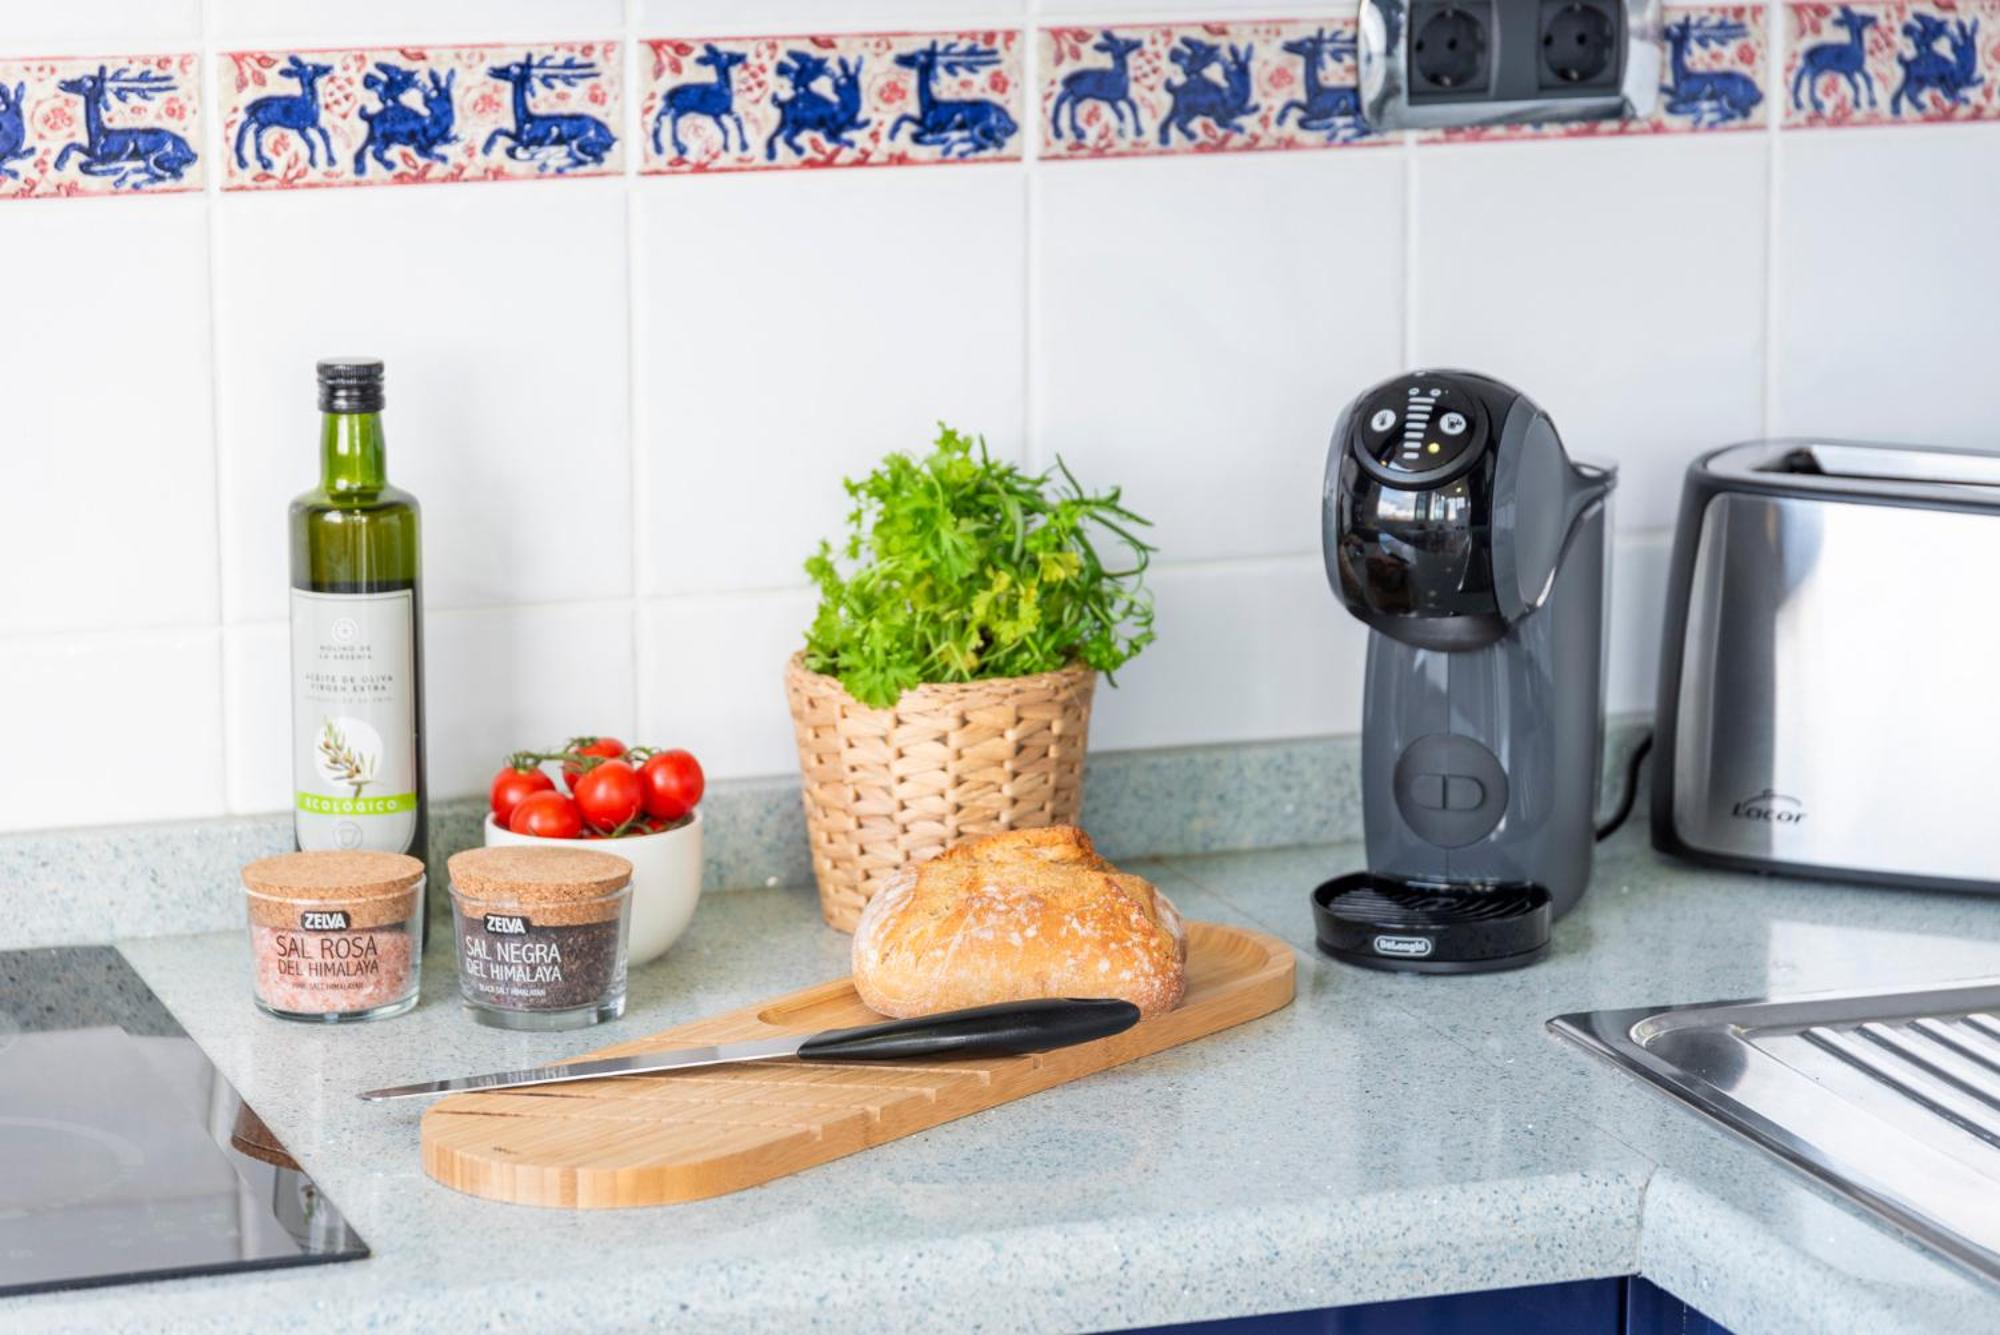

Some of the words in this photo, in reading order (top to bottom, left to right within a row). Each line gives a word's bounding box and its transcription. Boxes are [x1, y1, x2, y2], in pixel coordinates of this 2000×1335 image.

[1732, 802, 1808, 823] Lacor
[304, 913, 346, 929] ZELVA
[486, 915, 526, 934] ZELVA
[276, 934, 313, 960] SAL
[320, 934, 378, 960] ROSA
[465, 935, 492, 961] SAL
[497, 942, 562, 964] NEGRA
[278, 958, 304, 976] DEL
[308, 958, 379, 977] HIMALAYA
[466, 957, 488, 978] DEL
[490, 963, 562, 983] HIMALAYA
